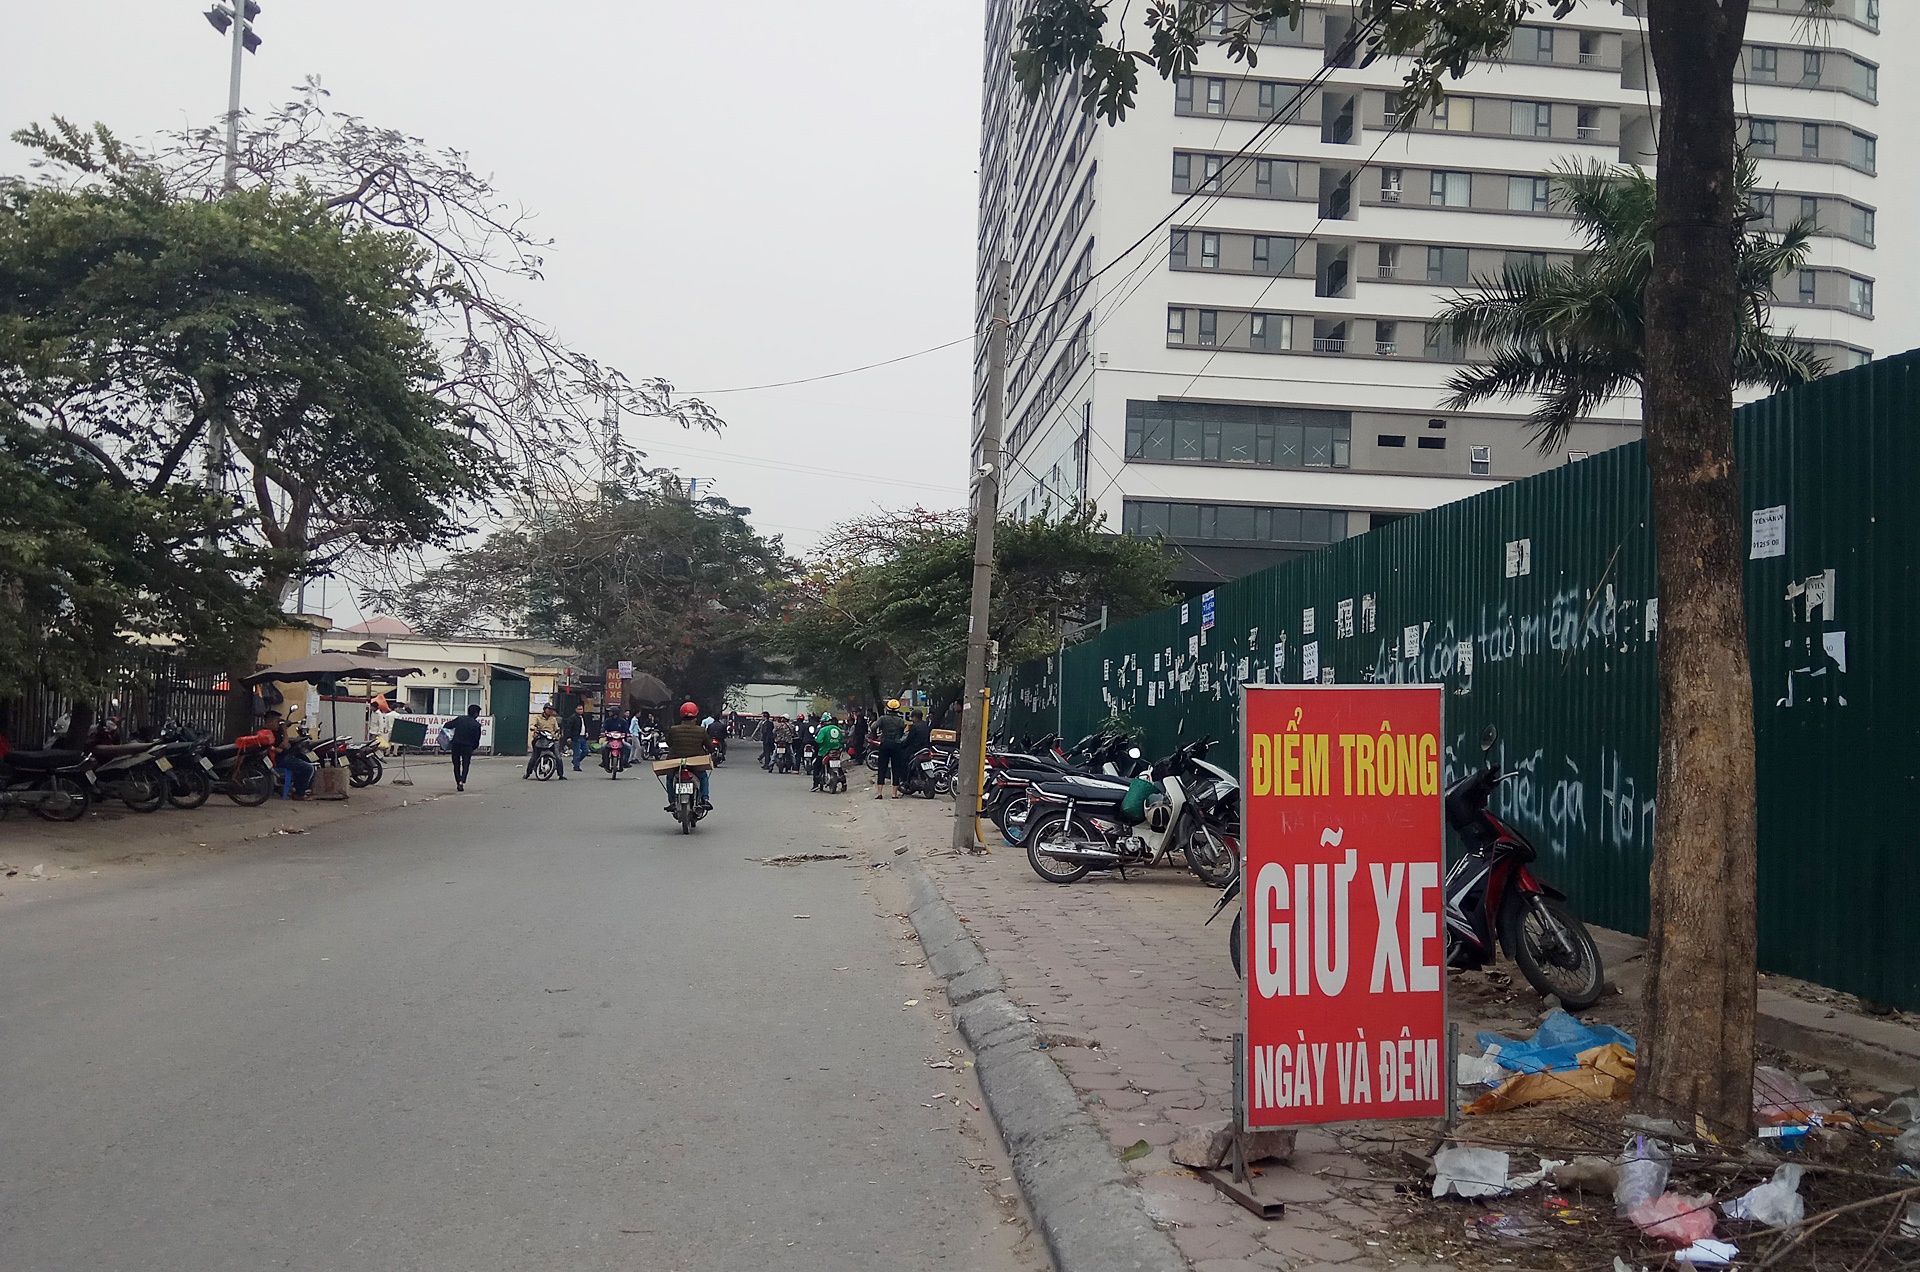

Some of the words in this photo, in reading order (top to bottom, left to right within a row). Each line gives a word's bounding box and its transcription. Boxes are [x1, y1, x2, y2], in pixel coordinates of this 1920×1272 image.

[1251, 706, 1330, 797] ĐIỂM
[1339, 720, 1438, 796] TRÔNG
[1254, 827, 1358, 999] GIỮ
[1369, 861, 1440, 994] XE
[1254, 1029, 1329, 1109] NGÀY
[1336, 1027, 1373, 1105] VÀ
[1379, 1026, 1439, 1104] ĐÊM
